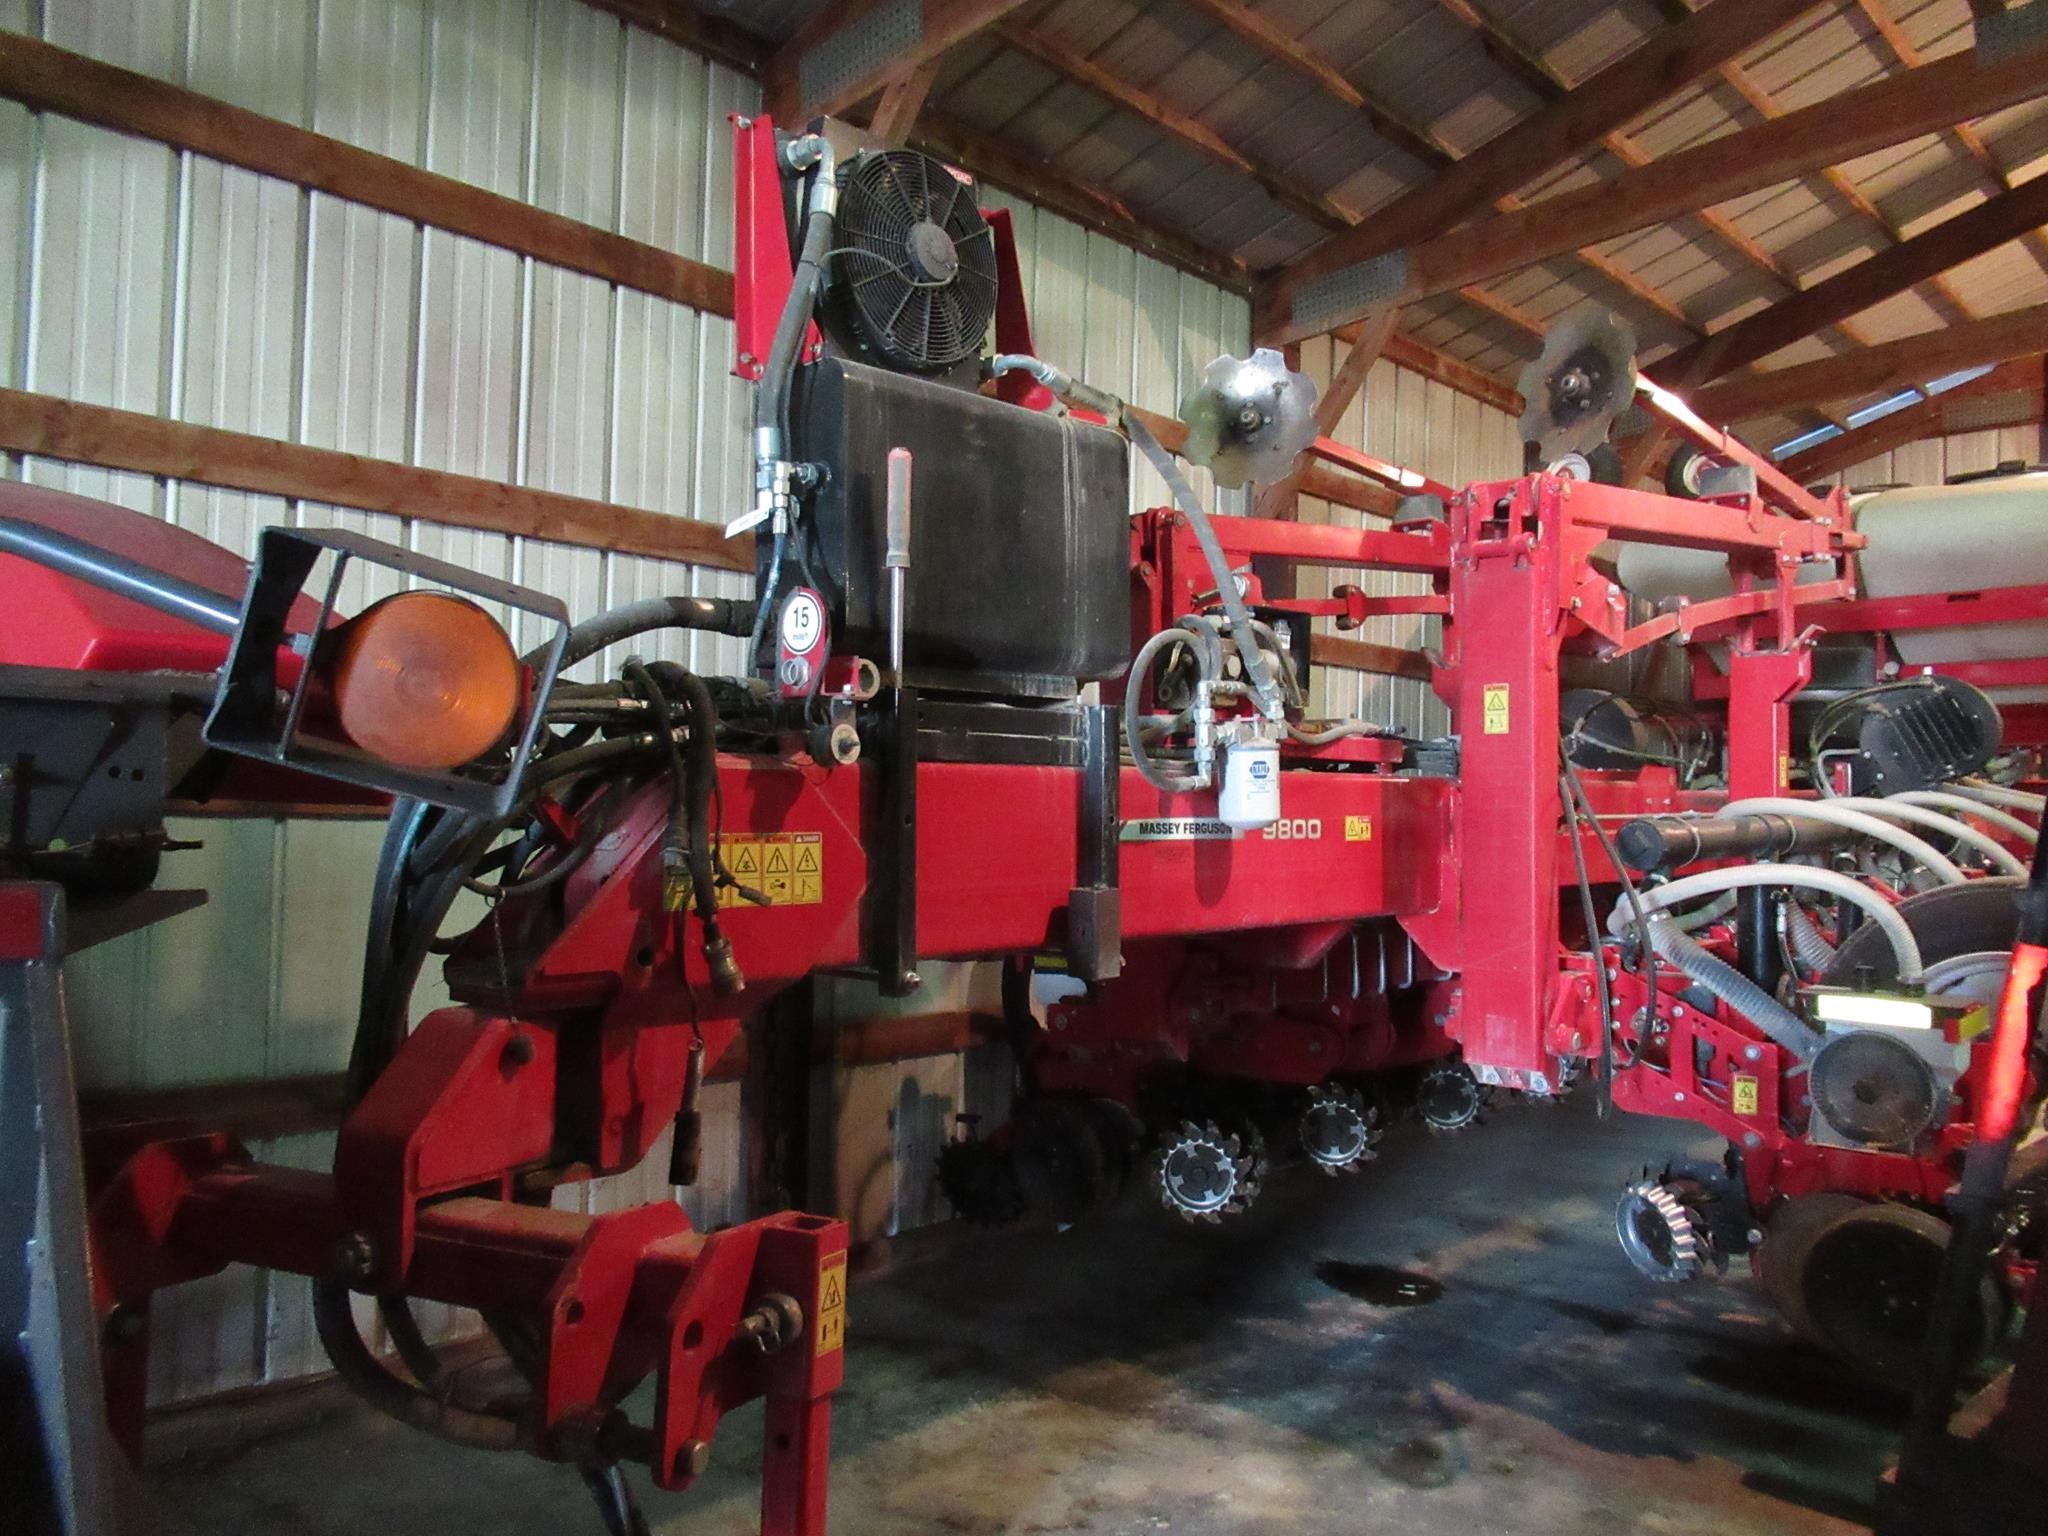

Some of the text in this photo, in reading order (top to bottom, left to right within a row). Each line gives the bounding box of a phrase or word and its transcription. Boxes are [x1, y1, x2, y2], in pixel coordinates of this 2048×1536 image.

[793, 606, 809, 629] 15
[1139, 822, 1181, 835] MASSEY
[1263, 819, 1321, 840] 9800
